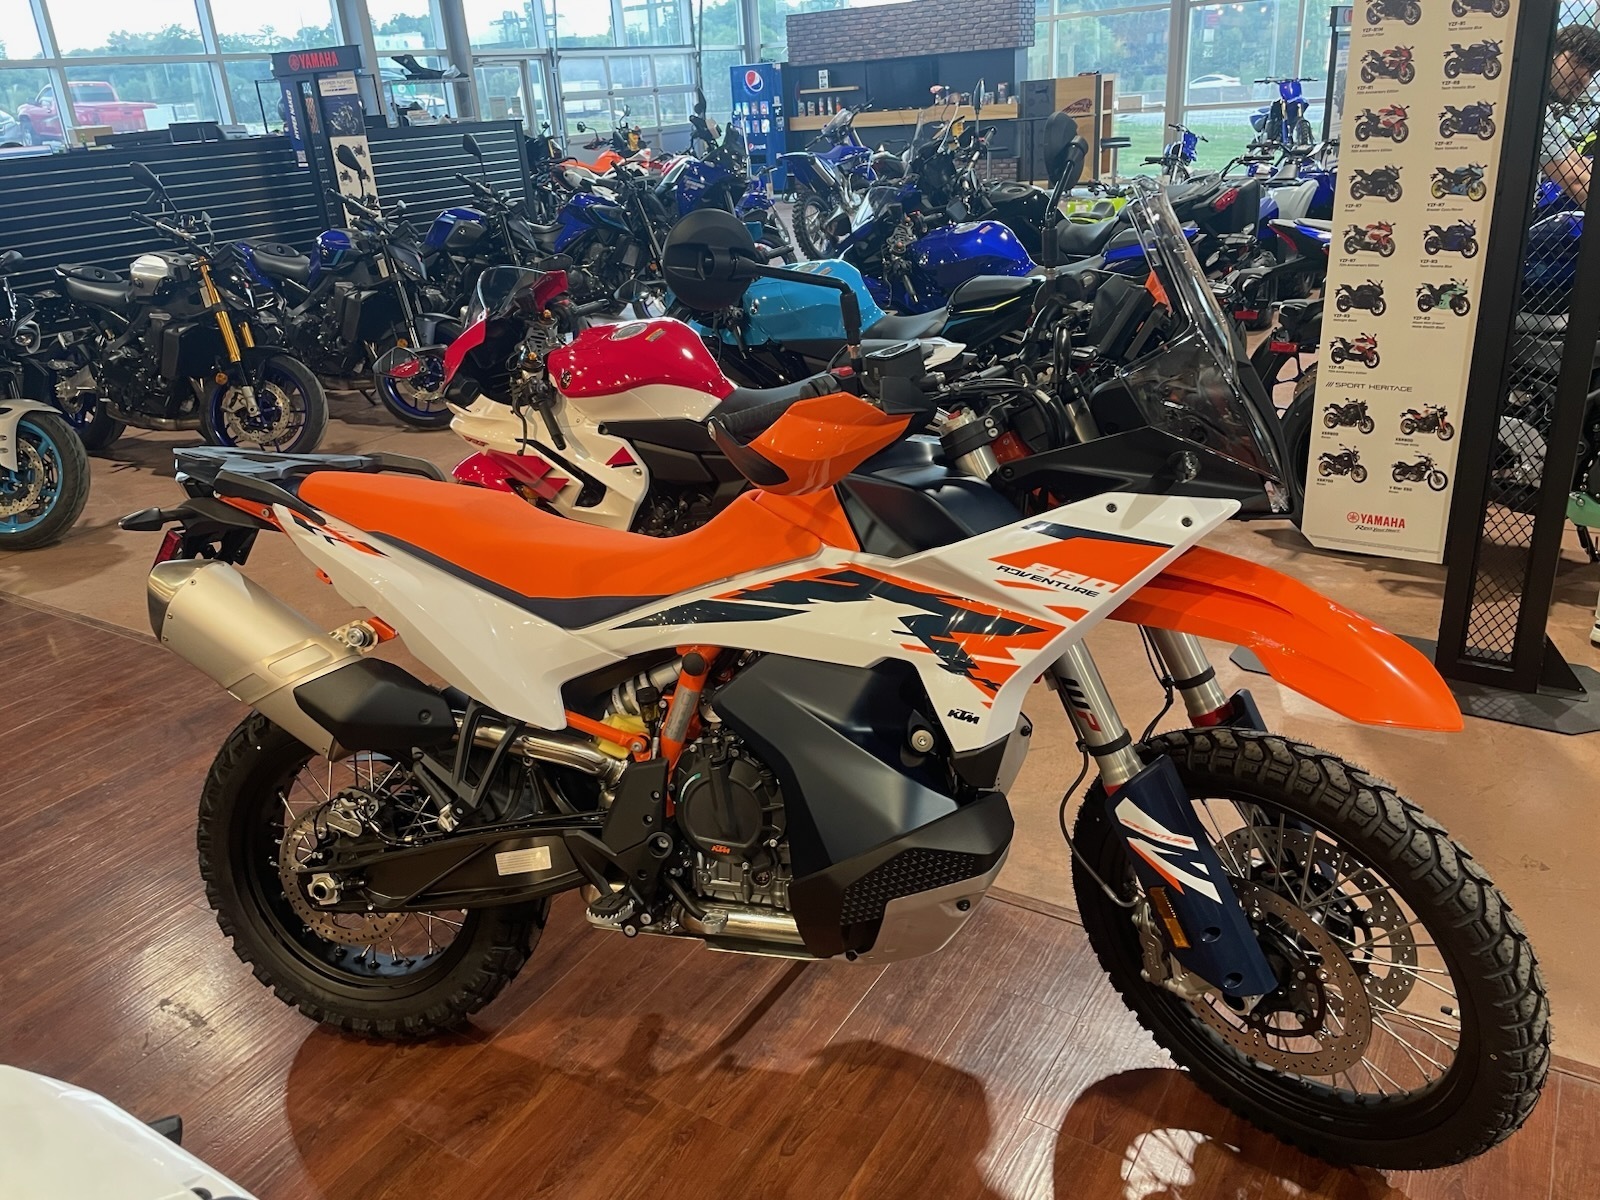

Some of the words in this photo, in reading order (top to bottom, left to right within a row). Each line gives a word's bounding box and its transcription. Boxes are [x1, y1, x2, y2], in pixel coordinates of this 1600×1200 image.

[298, 51, 339, 69] YAMAHA
[285, 89, 296, 116] NAKED
[291, 115, 301, 141] HYPER
[1334, 382, 1367, 390] SPORT
[1368, 384, 1413, 393] HERITAGE
[1360, 513, 1405, 529] YAMAHA
[996, 565, 1100, 598] ADVENTURE
[947, 708, 980, 725] KTM
[711, 845, 731, 854] KTM
